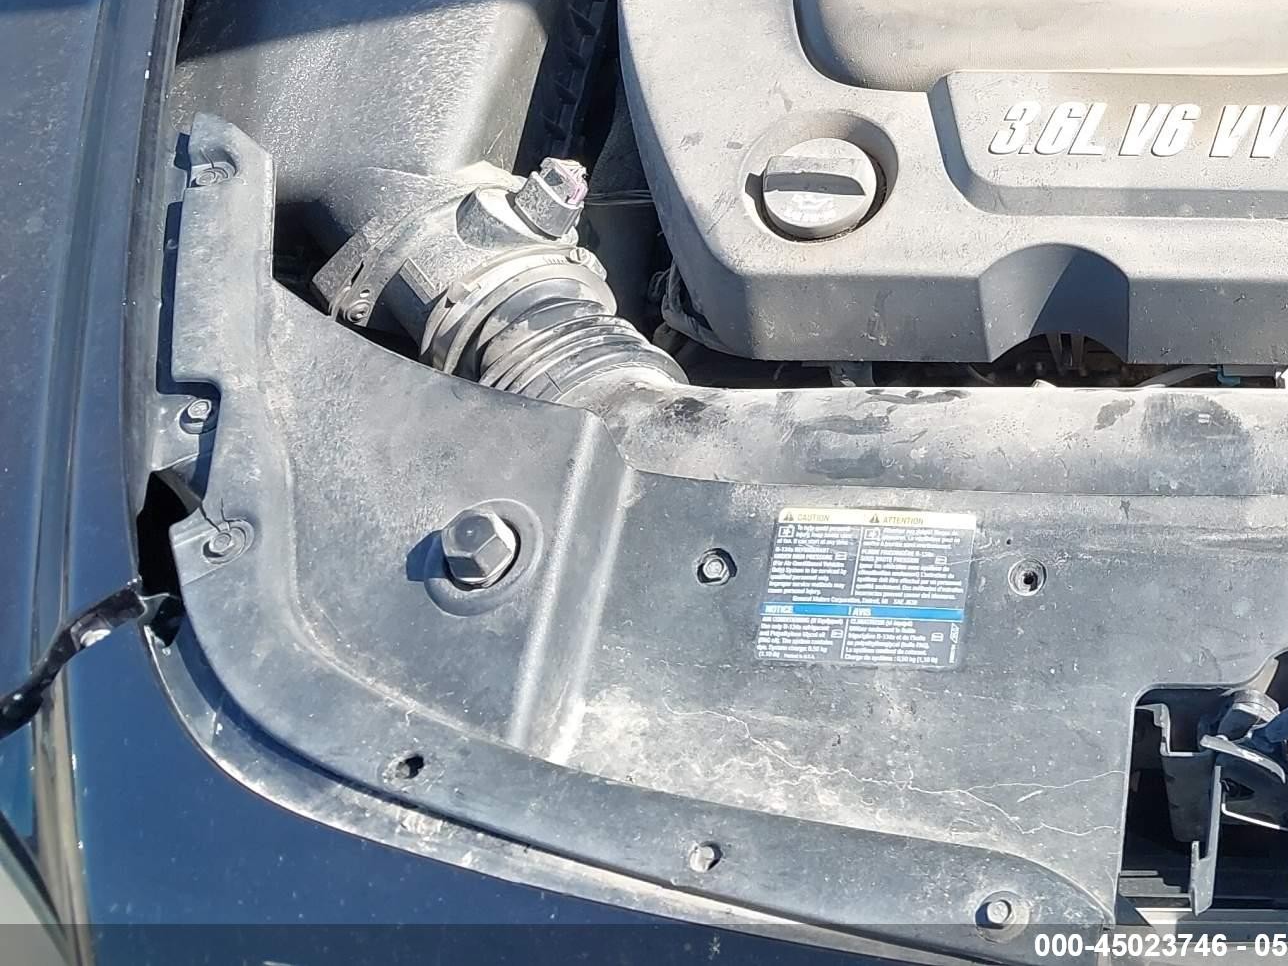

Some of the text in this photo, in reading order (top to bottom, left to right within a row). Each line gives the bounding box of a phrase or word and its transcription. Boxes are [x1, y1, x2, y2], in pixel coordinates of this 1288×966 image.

[988, 101, 1109, 156] 3.6L
[1118, 103, 1199, 158] V6
[797, 513, 830, 522] CAUTION
[882, 516, 924, 525] ATTENTION
[765, 605, 794, 614] NOTICE
[852, 608, 872, 616] AVIS
